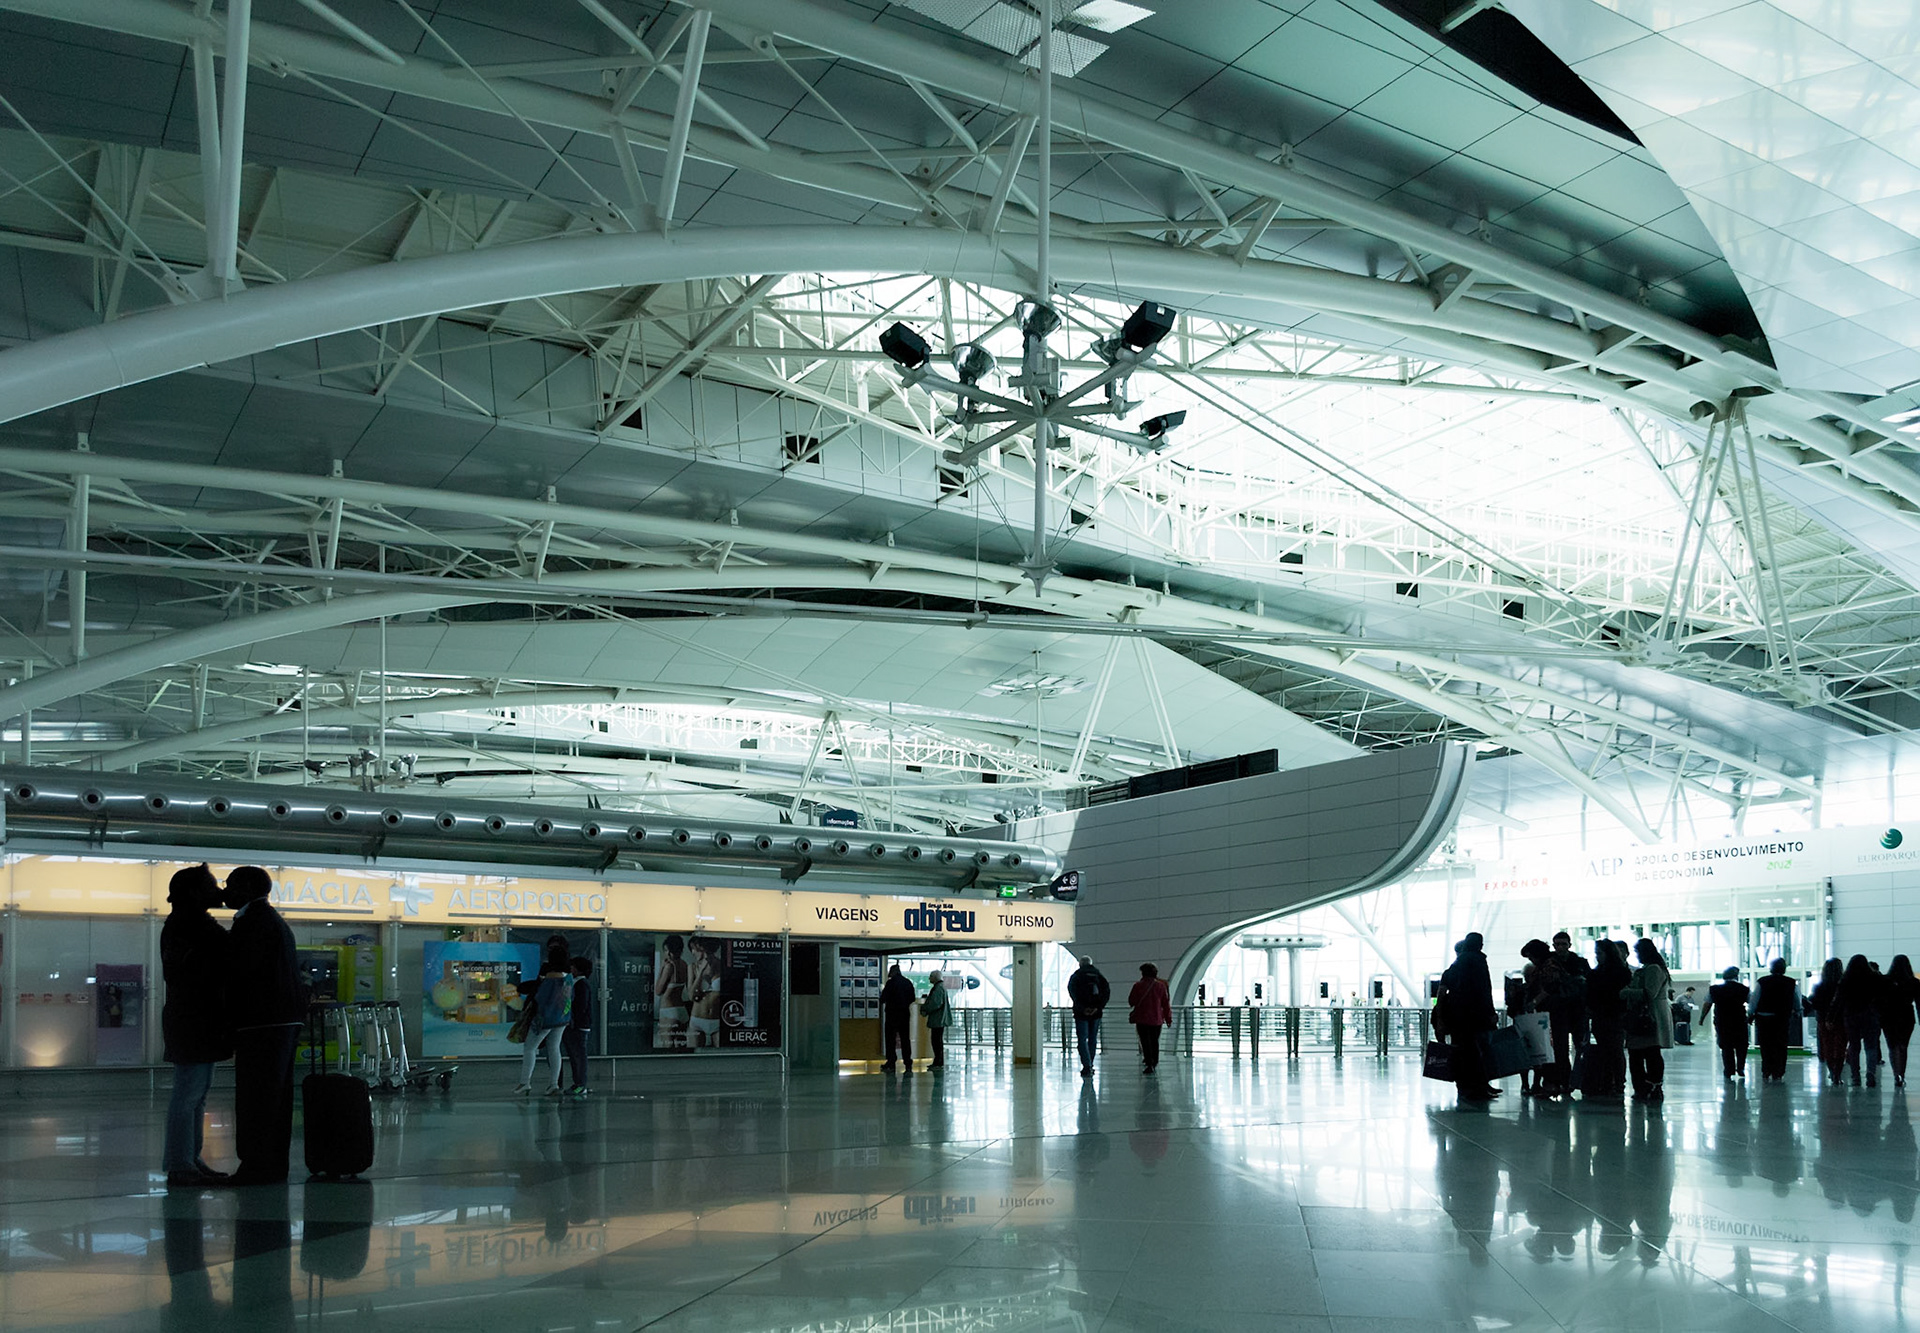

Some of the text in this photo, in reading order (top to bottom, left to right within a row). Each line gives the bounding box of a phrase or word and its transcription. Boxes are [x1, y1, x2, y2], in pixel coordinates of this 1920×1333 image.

[1635, 841, 1804, 867] APOIA O DESENVOLVIMENTO
[1857, 850, 1920, 863] EUROPARQU
[1585, 857, 1624, 878] AEP
[1634, 865, 1714, 882] DA ECONOMIA
[1484, 877, 1549, 891] EXPONOR
[271, 878, 606, 914] MÁCIA AEROPORTO
[815, 902, 1054, 932] VIAGENS abreu TURISMO
[624, 961, 655, 974] Farm
[621, 1000, 654, 1014] Aerop
[729, 1031, 768, 1042] LIERAC
